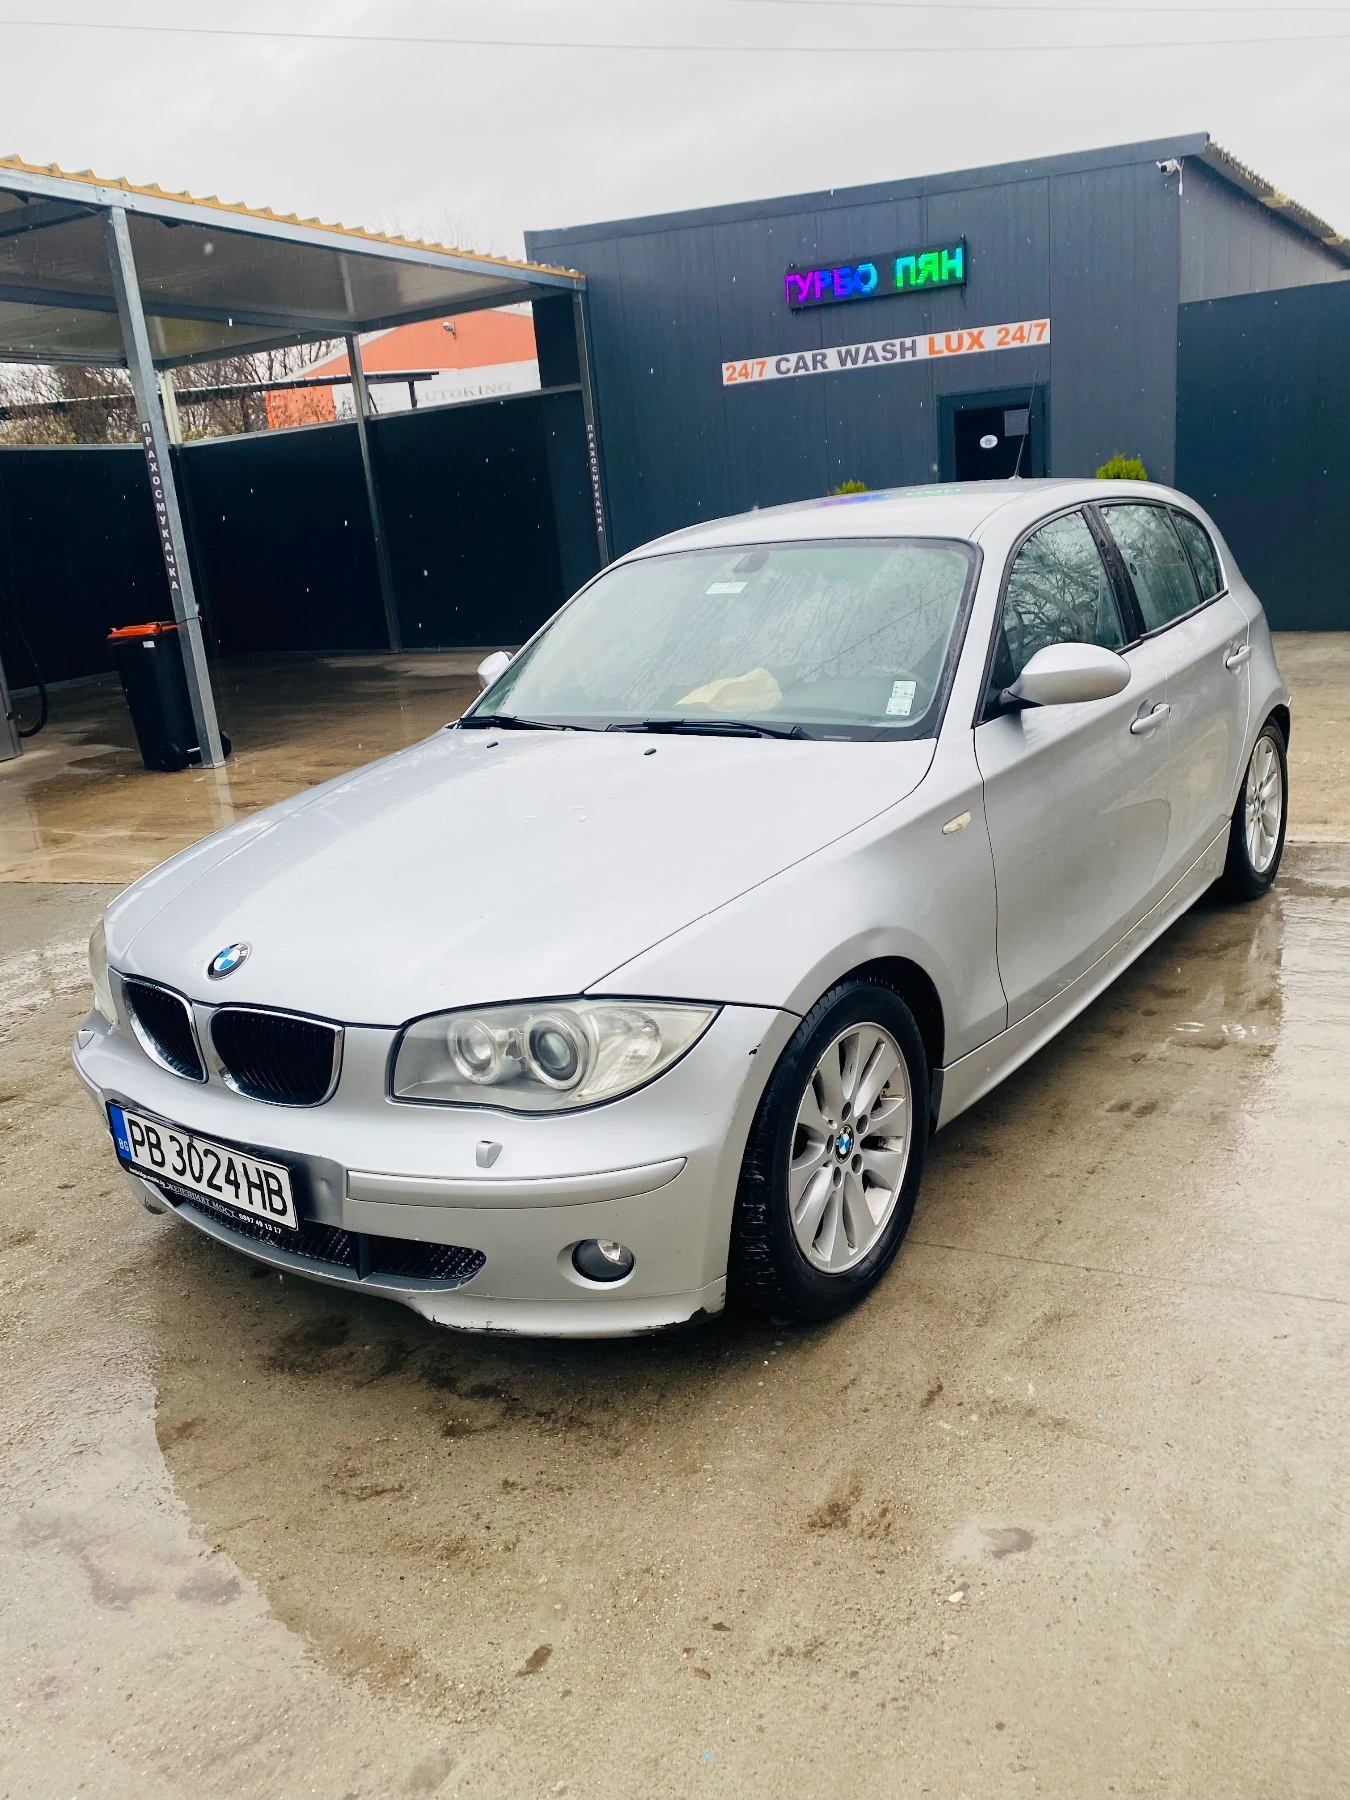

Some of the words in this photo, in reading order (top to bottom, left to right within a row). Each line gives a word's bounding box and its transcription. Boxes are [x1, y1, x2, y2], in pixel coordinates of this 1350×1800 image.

[894, 247, 963, 288] ПЯН
[725, 359, 767, 382] 24/7
[775, 351, 829, 375] CAR
[836, 339, 917, 368] WASH
[928, 329, 986, 356] LUX
[996, 321, 1048, 347] 24/7
[142, 422, 179, 590] ПРАХОСМУКАЧКА
[587, 424, 604, 532] ПРАХОСМУКАЧКА
[117, 1137, 130, 1152] BG
[127, 1117, 166, 1168] PB
[169, 1134, 241, 1200] 3024
[242, 1162, 288, 1217] HB
